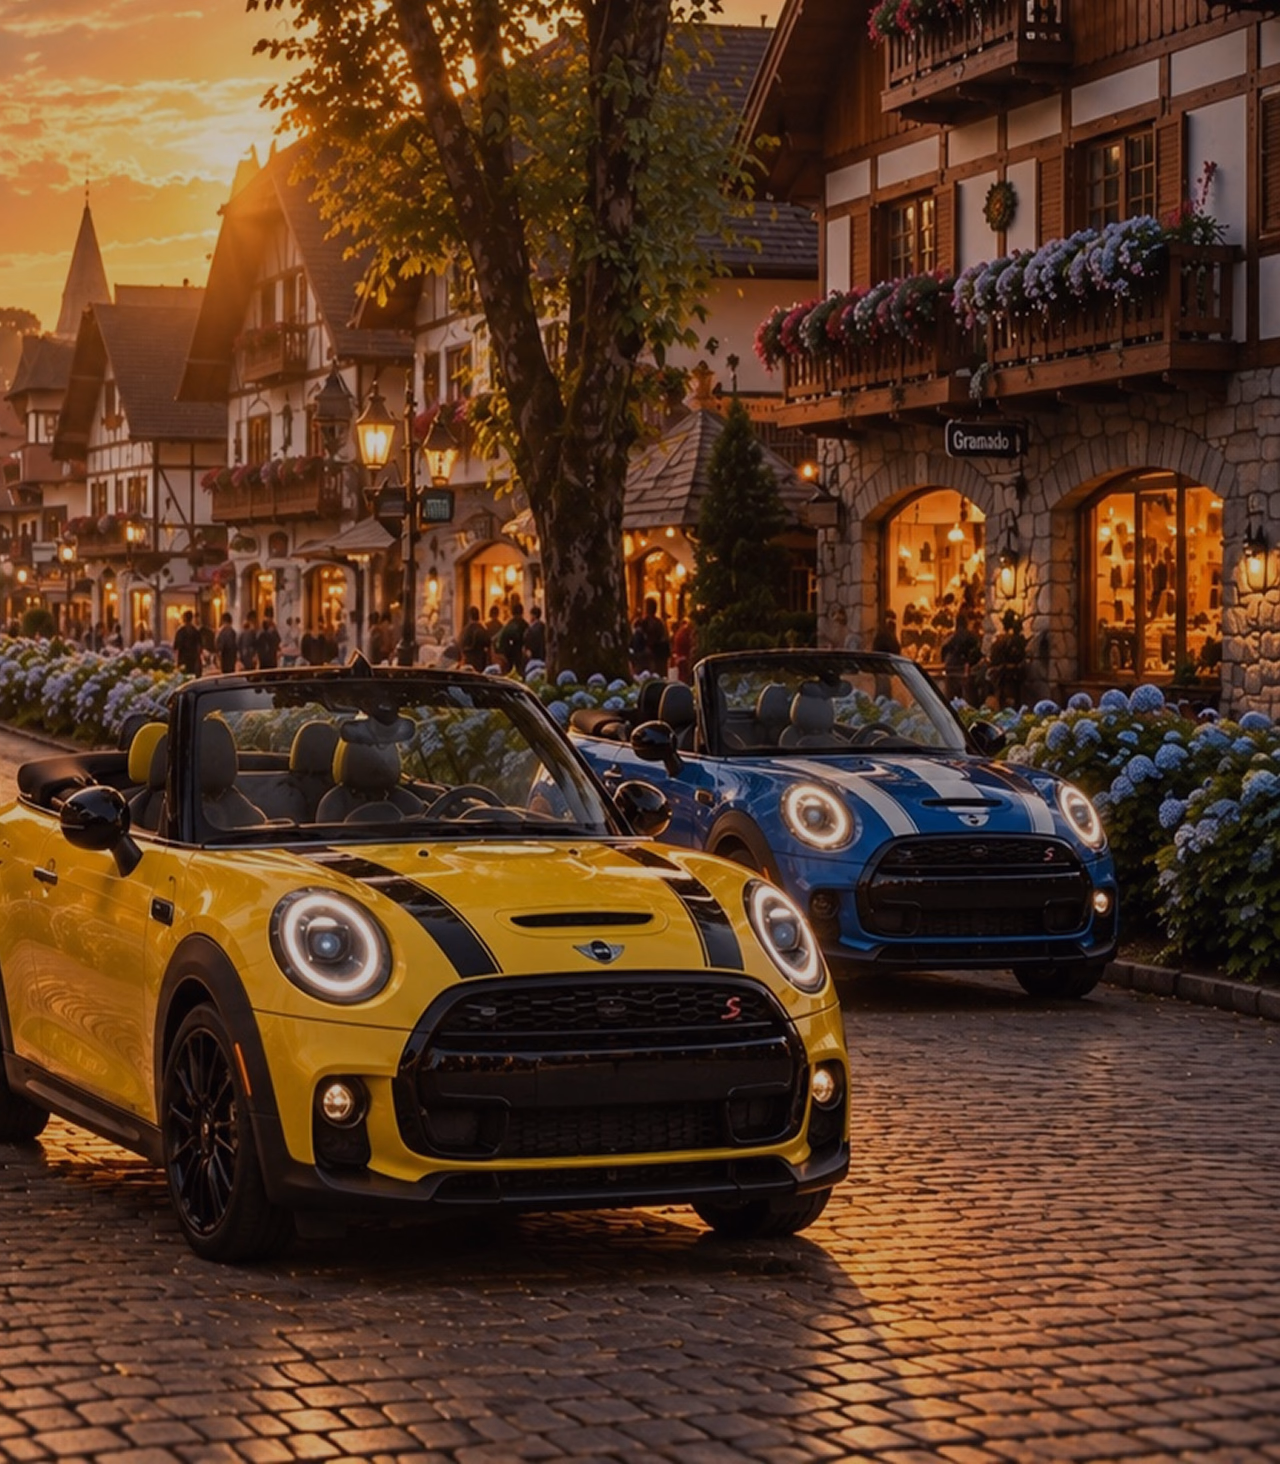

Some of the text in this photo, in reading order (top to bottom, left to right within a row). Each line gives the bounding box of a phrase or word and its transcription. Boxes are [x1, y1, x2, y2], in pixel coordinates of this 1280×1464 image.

[953, 430, 1010, 450] Gramado
[1042, 846, 1056, 861] S
[720, 996, 742, 1020] S
